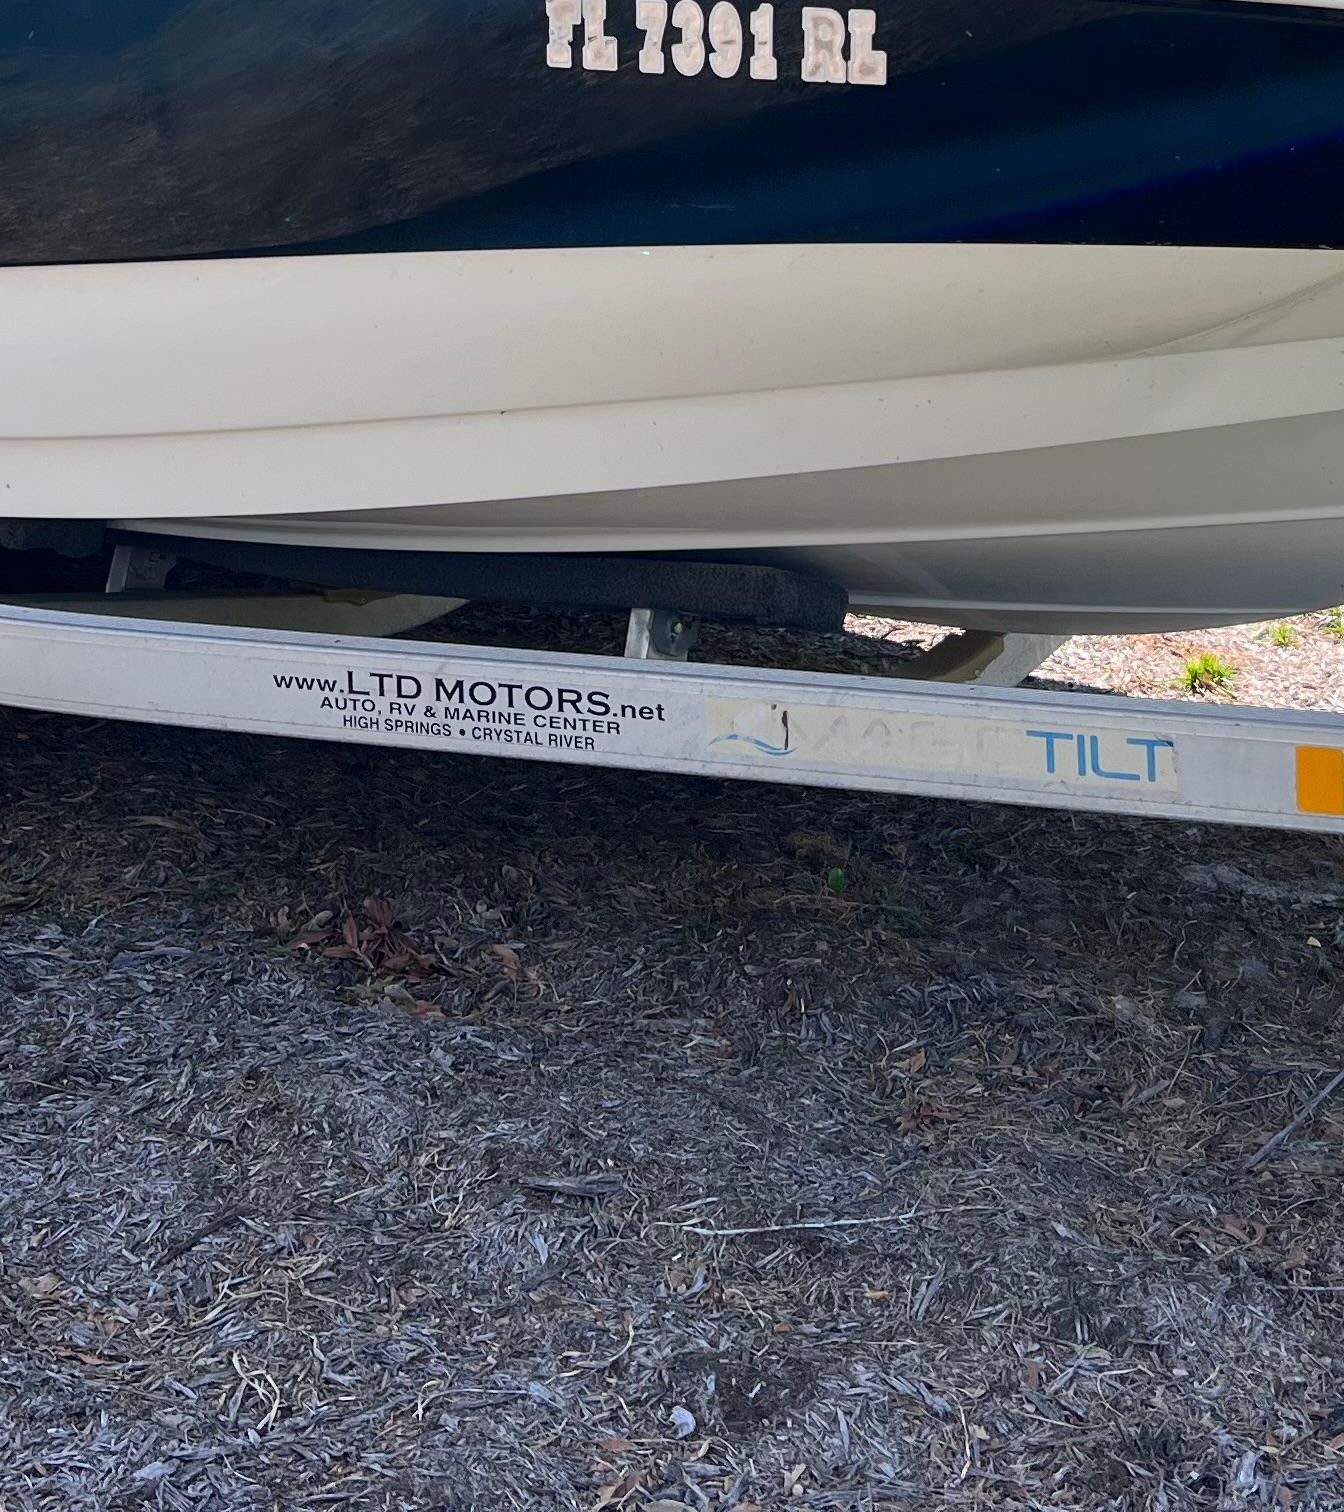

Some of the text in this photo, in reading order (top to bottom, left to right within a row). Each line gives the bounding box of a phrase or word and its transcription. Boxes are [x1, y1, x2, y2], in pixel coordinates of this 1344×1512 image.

[801, 6, 887, 86] RL
[320, 696, 622, 736] AUTO, RV & MARINE CENTER
[343, 714, 596, 751] HIGH SPRINGS CRYSTAL RIVER
[1025, 729, 1173, 783] TILT
